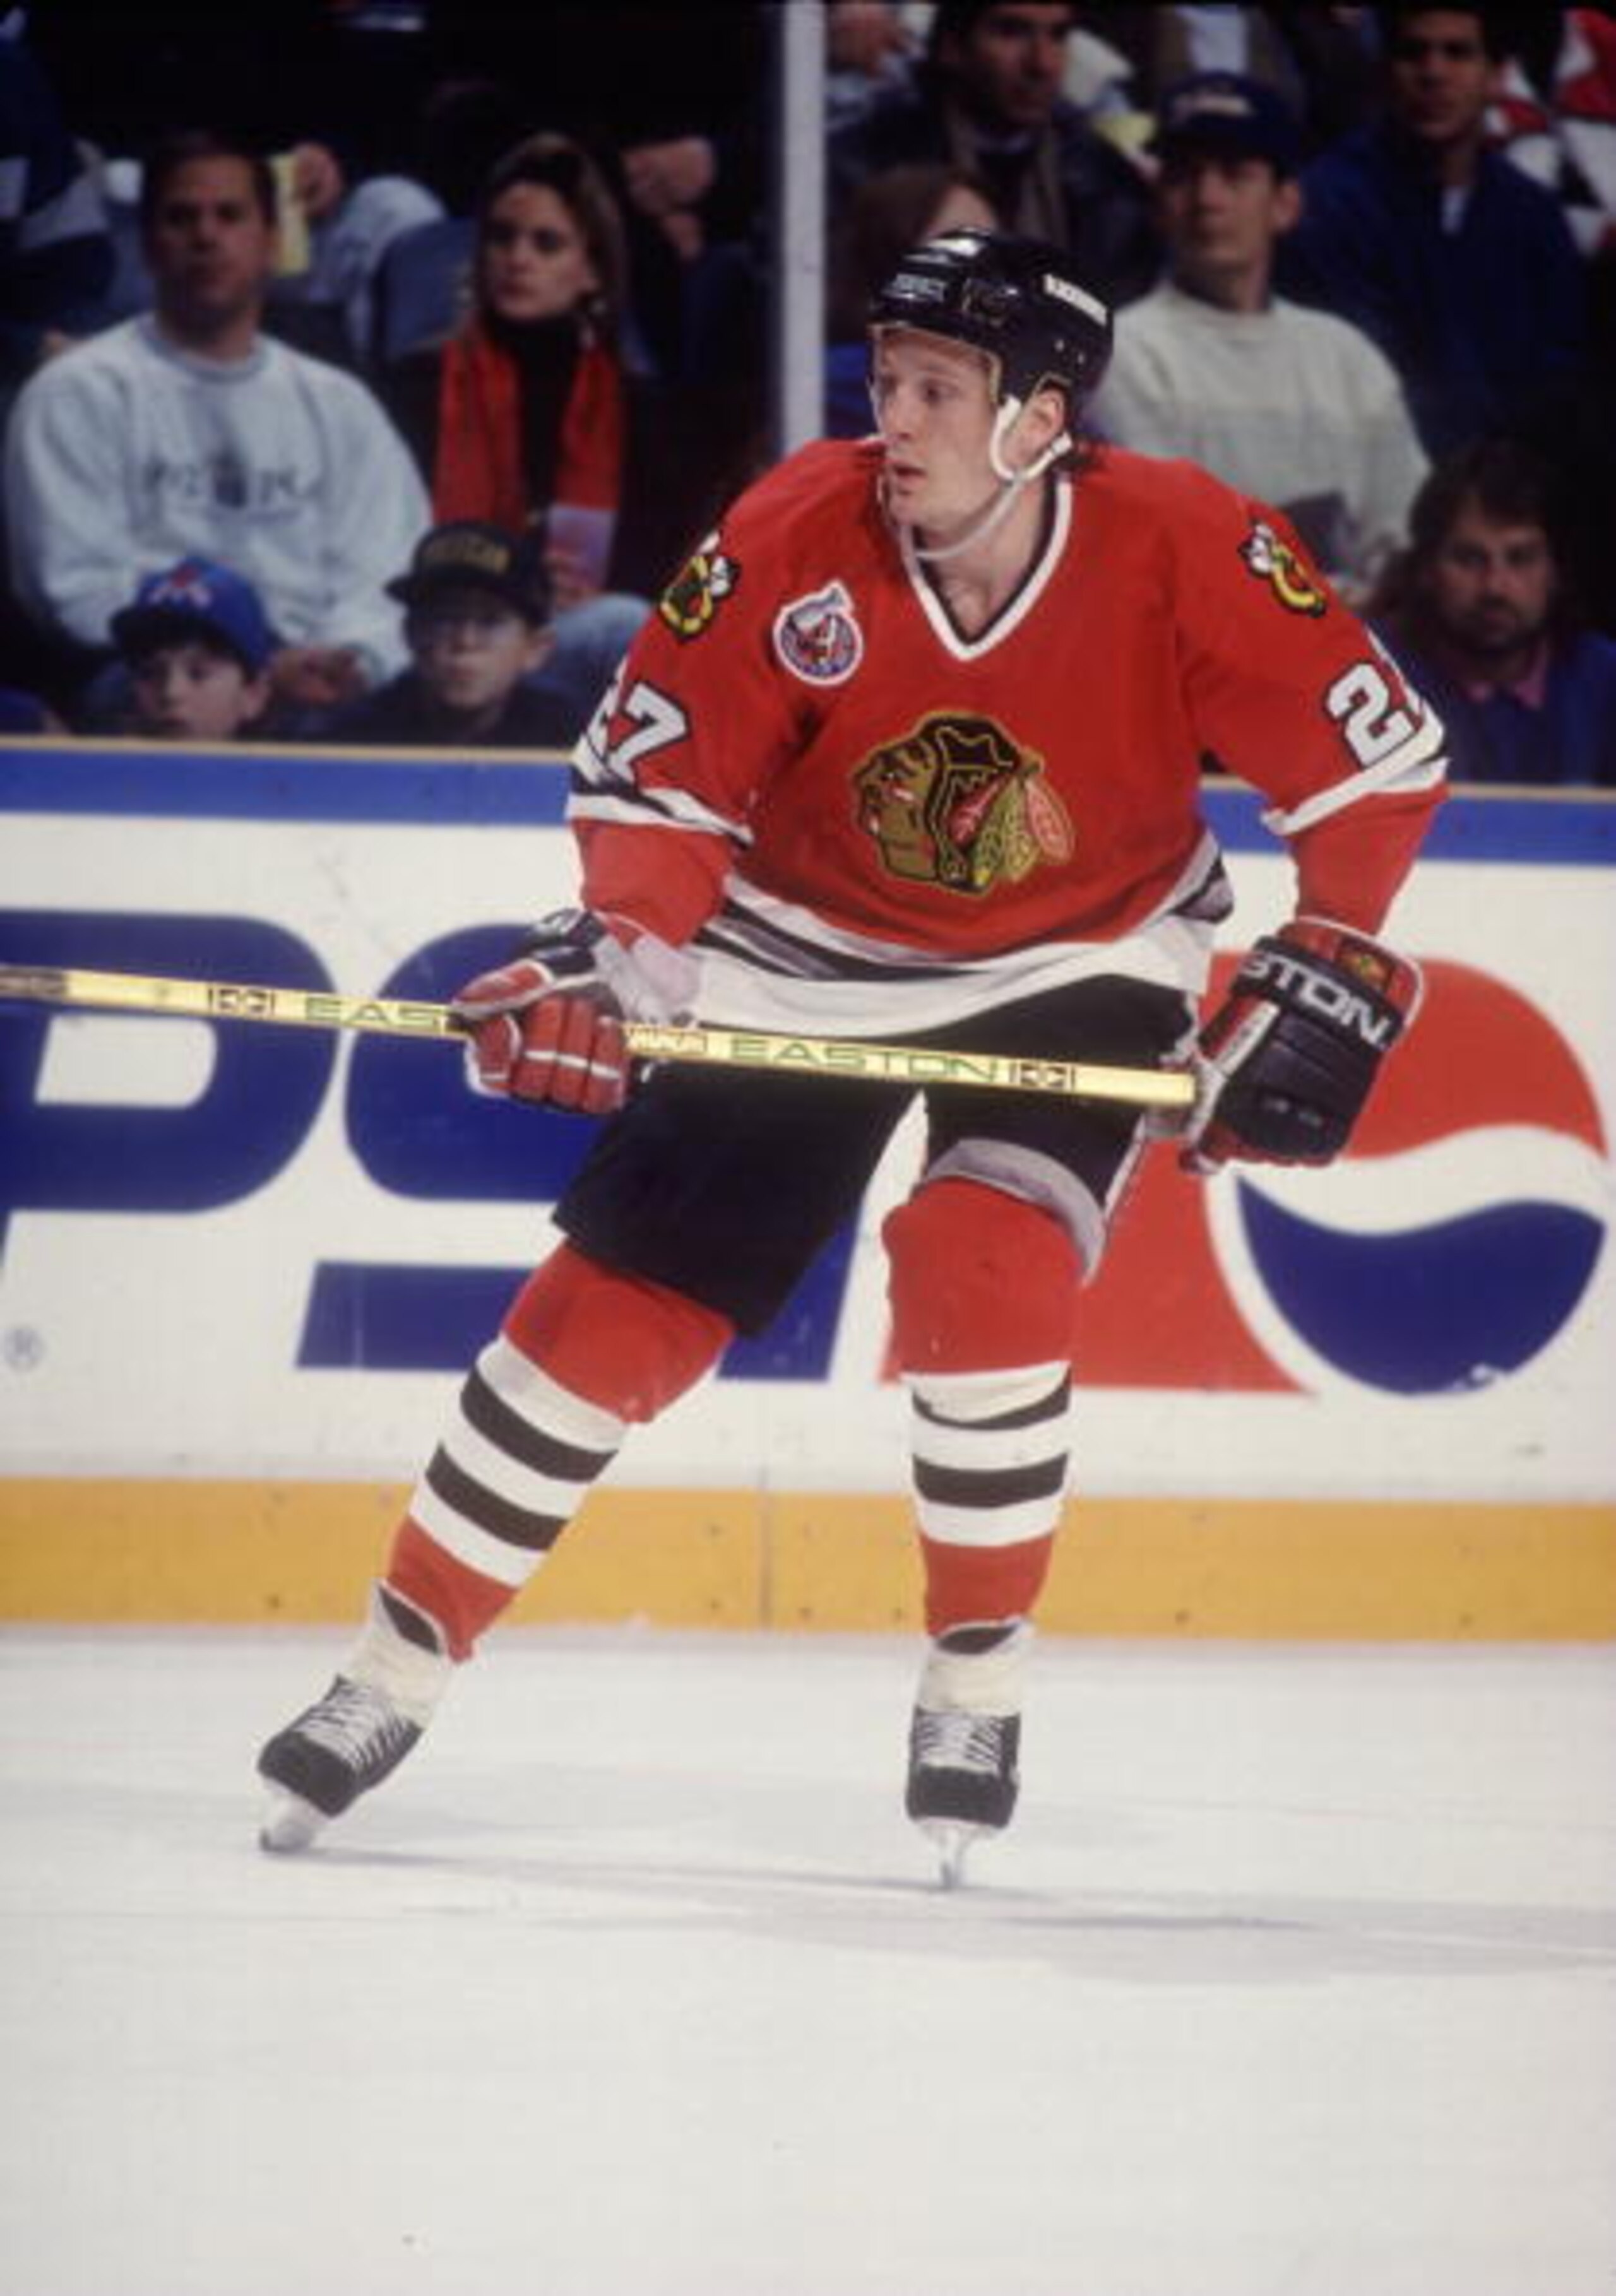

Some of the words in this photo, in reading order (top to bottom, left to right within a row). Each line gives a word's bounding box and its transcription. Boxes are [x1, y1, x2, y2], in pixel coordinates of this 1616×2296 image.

[1326, 661, 1420, 768] 2
[306, 997, 446, 1027] EAS
[730, 1037, 998, 1083] EASTON
